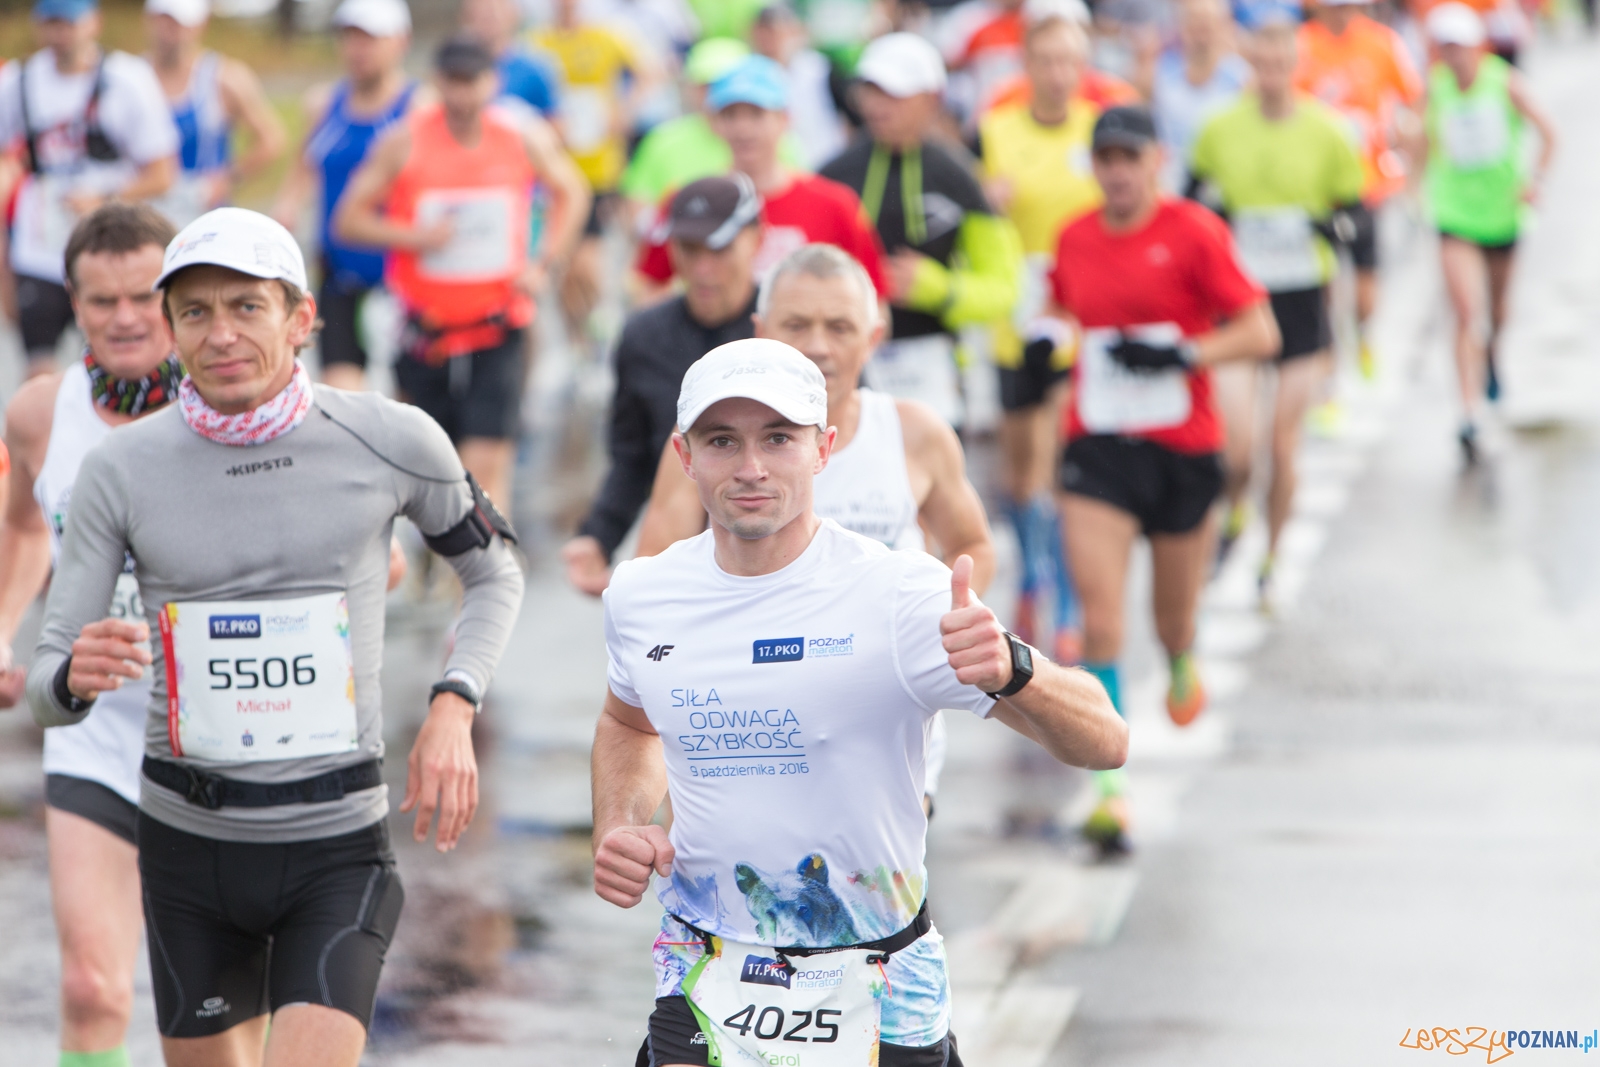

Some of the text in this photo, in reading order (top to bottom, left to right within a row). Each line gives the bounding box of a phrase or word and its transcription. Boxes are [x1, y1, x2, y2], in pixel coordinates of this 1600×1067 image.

[646, 644, 675, 662] 4F
[808, 645, 853, 655] maraton
[208, 654, 316, 690] 5506
[236, 698, 292, 714] Michał
[671, 688, 723, 708] SIŁA
[689, 708, 800, 730] ODWAGA
[678, 728, 805, 752] SZYBKOŚĆ
[689, 762, 810, 779] 9 października 2016
[796, 977, 843, 989] maraton
[723, 1003, 843, 1043] 4025
